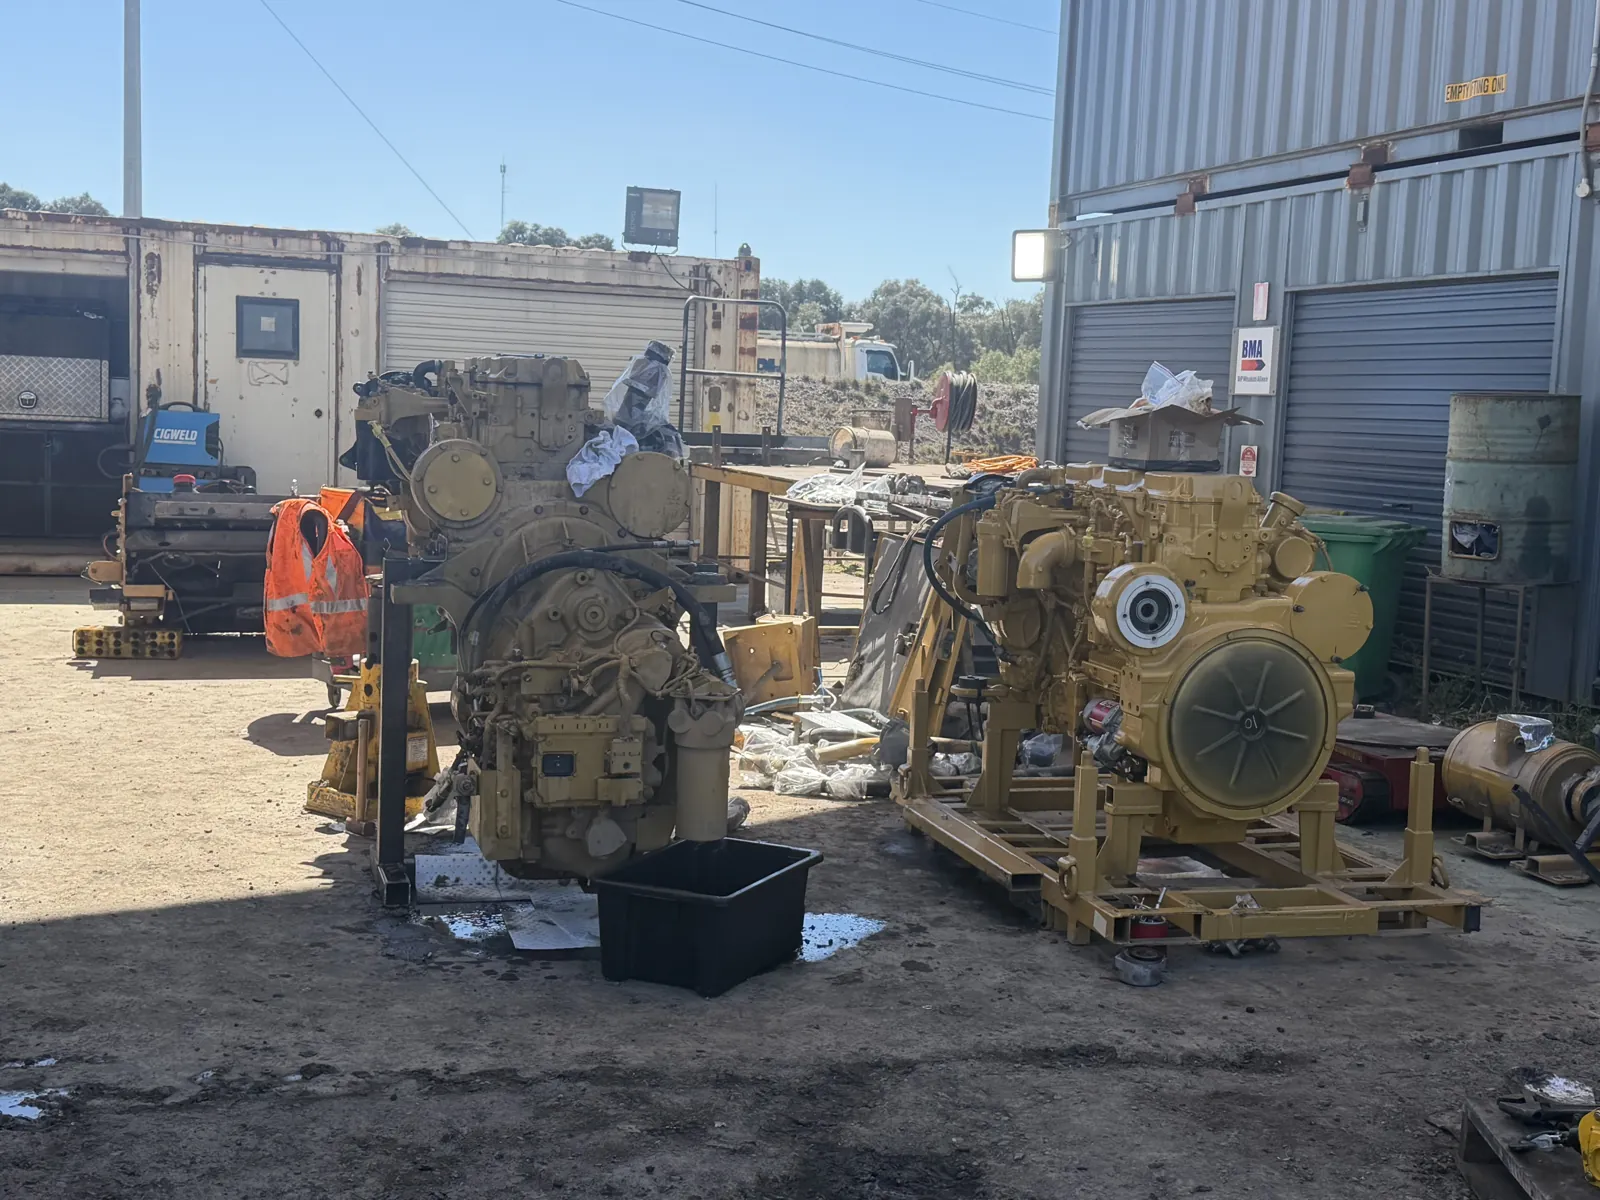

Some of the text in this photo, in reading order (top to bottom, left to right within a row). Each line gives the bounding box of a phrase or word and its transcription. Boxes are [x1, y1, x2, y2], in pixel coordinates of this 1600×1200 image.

[1446, 83, 1469, 101] EMPTY
[1491, 77, 1505, 92] ONL
[1242, 339, 1262, 358] BMA
[154, 428, 197, 440] CIGWELD
